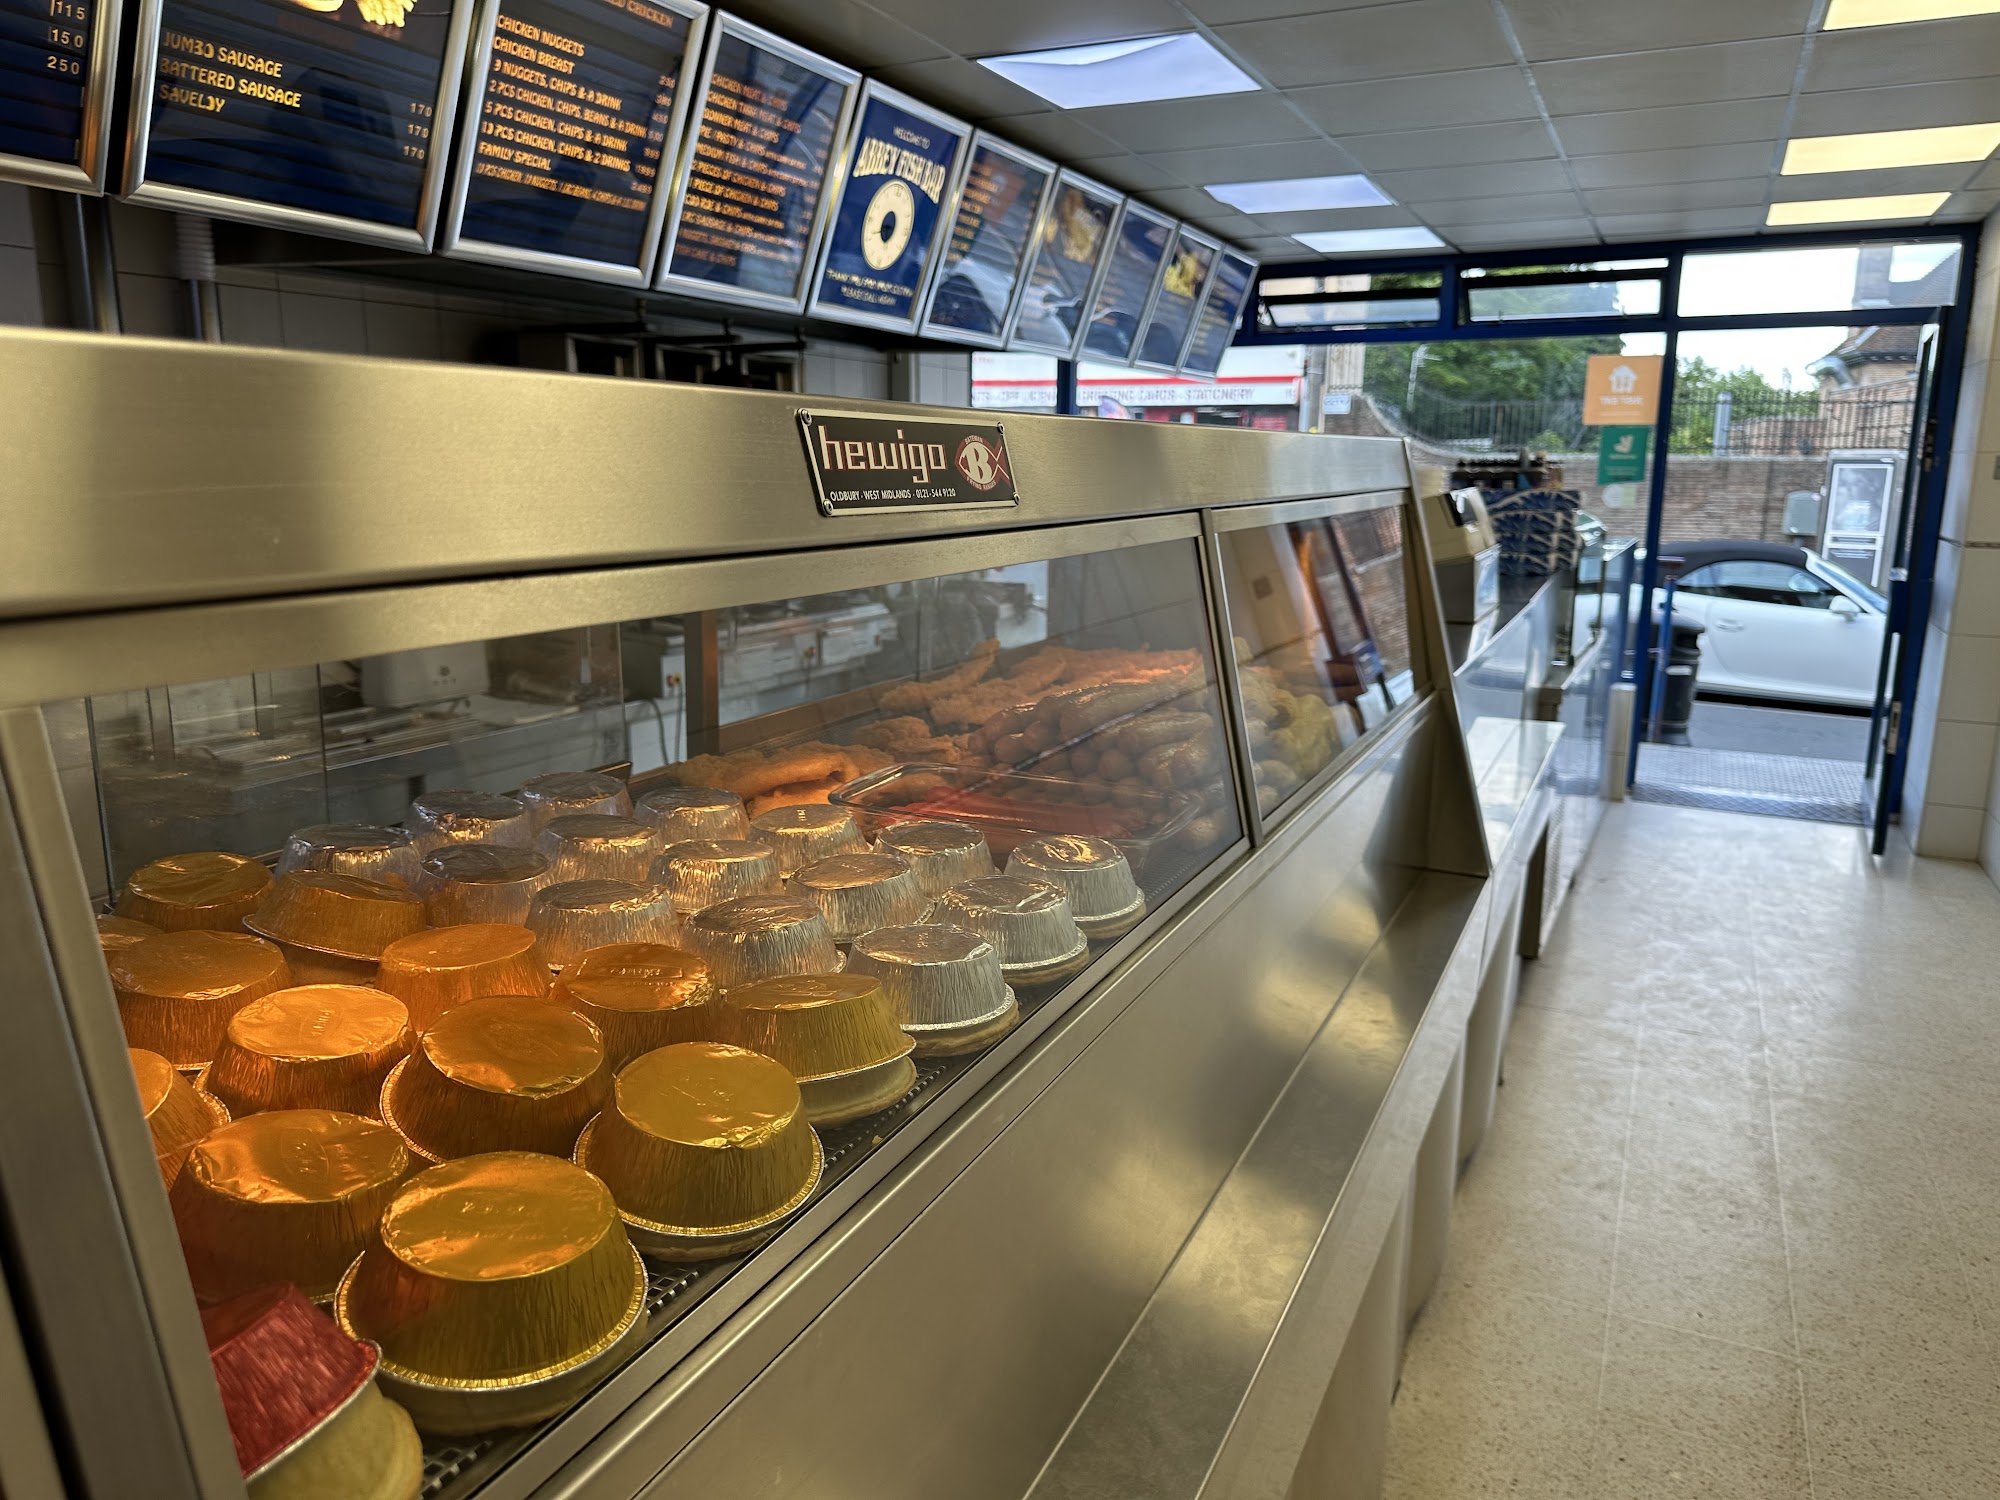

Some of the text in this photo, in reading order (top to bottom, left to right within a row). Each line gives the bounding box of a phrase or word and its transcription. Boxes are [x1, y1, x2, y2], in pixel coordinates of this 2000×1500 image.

[626, 0, 674, 28] CHICKEN
[52, 28, 83, 48] 150
[498, 15, 584, 56] CHICKEN NUGGETS
[47, 56, 80, 74] 250
[163, 32, 282, 78] JUMBO SAUSAGE
[493, 36, 575, 74] CHICKEN BREAST
[160, 58, 302, 108] BATTERED SAUSAGE
[160, 85, 225, 112] SAVELOY
[549, 78, 577, 96] CHIPS
[578, 86, 587, 100] &
[595, 92, 622, 111] DRINK
[410, 102, 432, 117] 170
[488, 80, 496, 92] 2
[496, 82, 516, 98] PCS
[582, 108, 610, 126] BEANS
[624, 122, 648, 138] DRINK
[408, 124, 429, 138] 170
[484, 100, 493, 114] 5
[493, 103, 514, 119] PCS
[556, 122, 585, 140] CHIPS
[602, 134, 628, 152] DRINK
[893, 126, 930, 150] WELCOME TO
[403, 146, 424, 160] 170
[478, 141, 551, 170] FAMILY SPECIAL
[494, 124, 514, 140] PCS
[556, 142, 585, 160] CHIPS
[593, 154, 600, 164] 2
[601, 154, 631, 172] DRINKS
[852, 136, 901, 177] ABBEY
[895, 150, 926, 186] FISH
[920, 161, 946, 204] BAR
[818, 424, 948, 484] hewigo
[830, 491, 860, 502] OLDBURY
[863, 490, 880, 500] WEST
[881, 489, 911, 500] MIDLANDS
